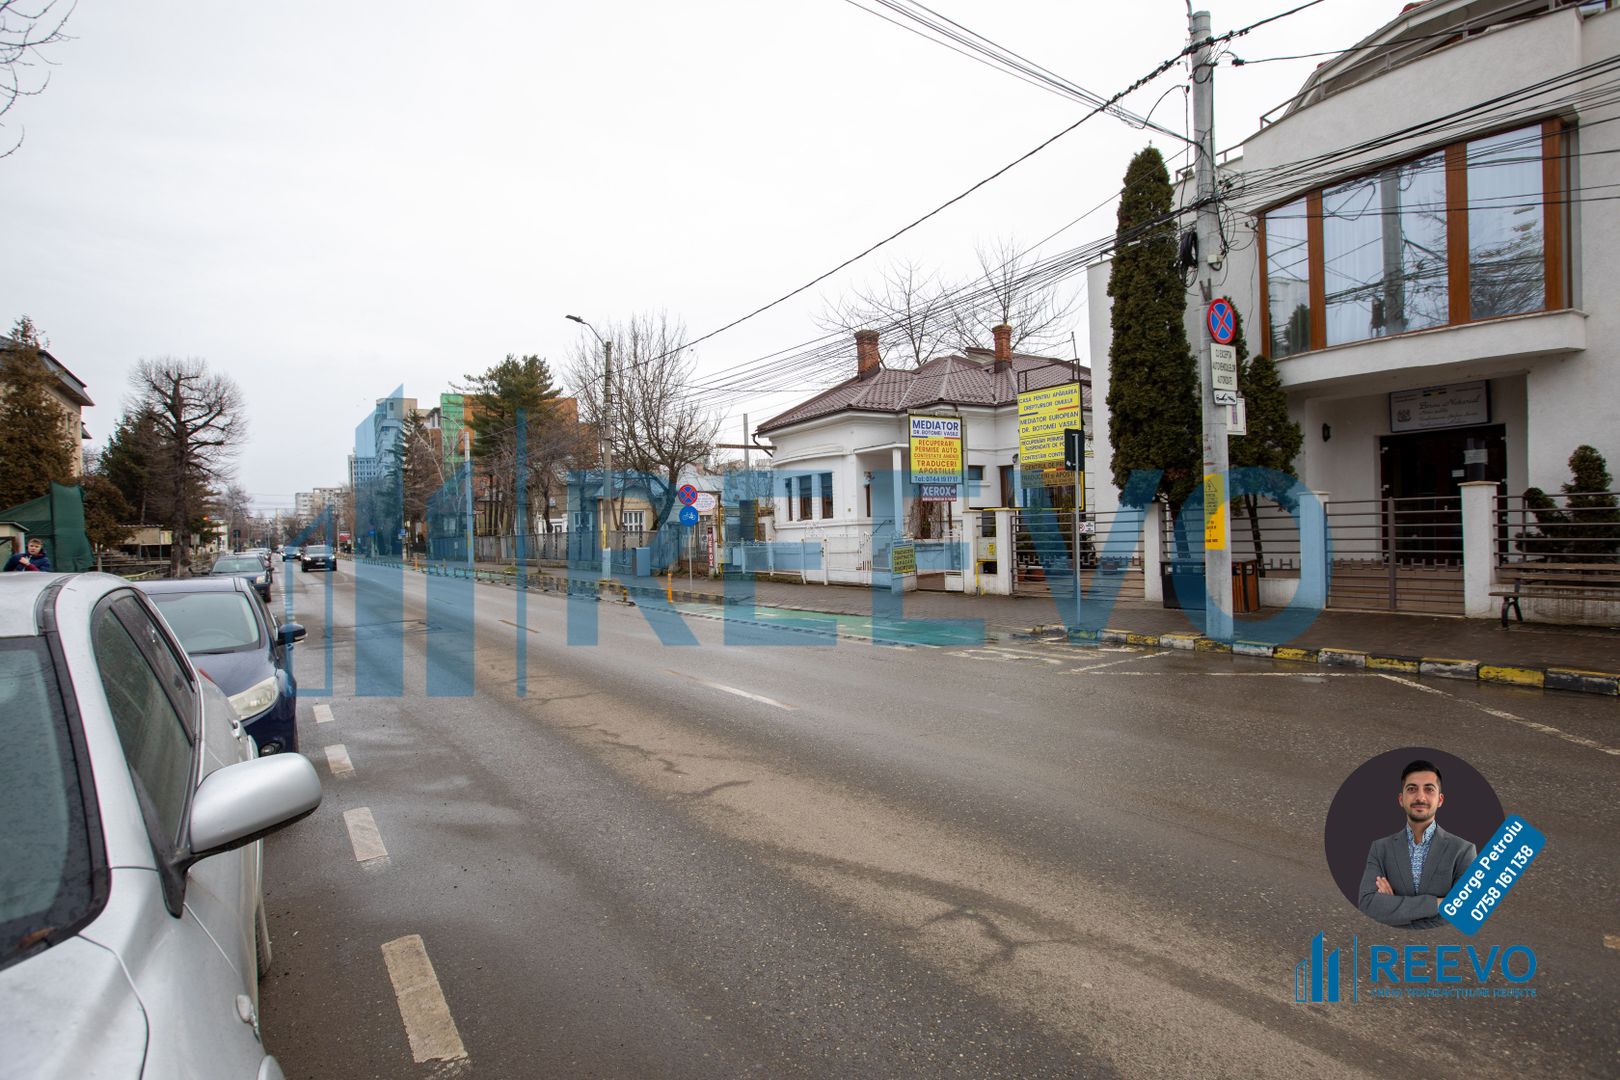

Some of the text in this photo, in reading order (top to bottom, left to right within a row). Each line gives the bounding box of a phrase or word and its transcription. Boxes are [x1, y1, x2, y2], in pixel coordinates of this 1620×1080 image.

[1020, 411, 1079, 425] MEDIATOR EUROPEAN
[912, 419, 959, 431] MEDIATOR
[1059, 420, 1077, 428] VASILE
[923, 486, 951, 496] XEROX
